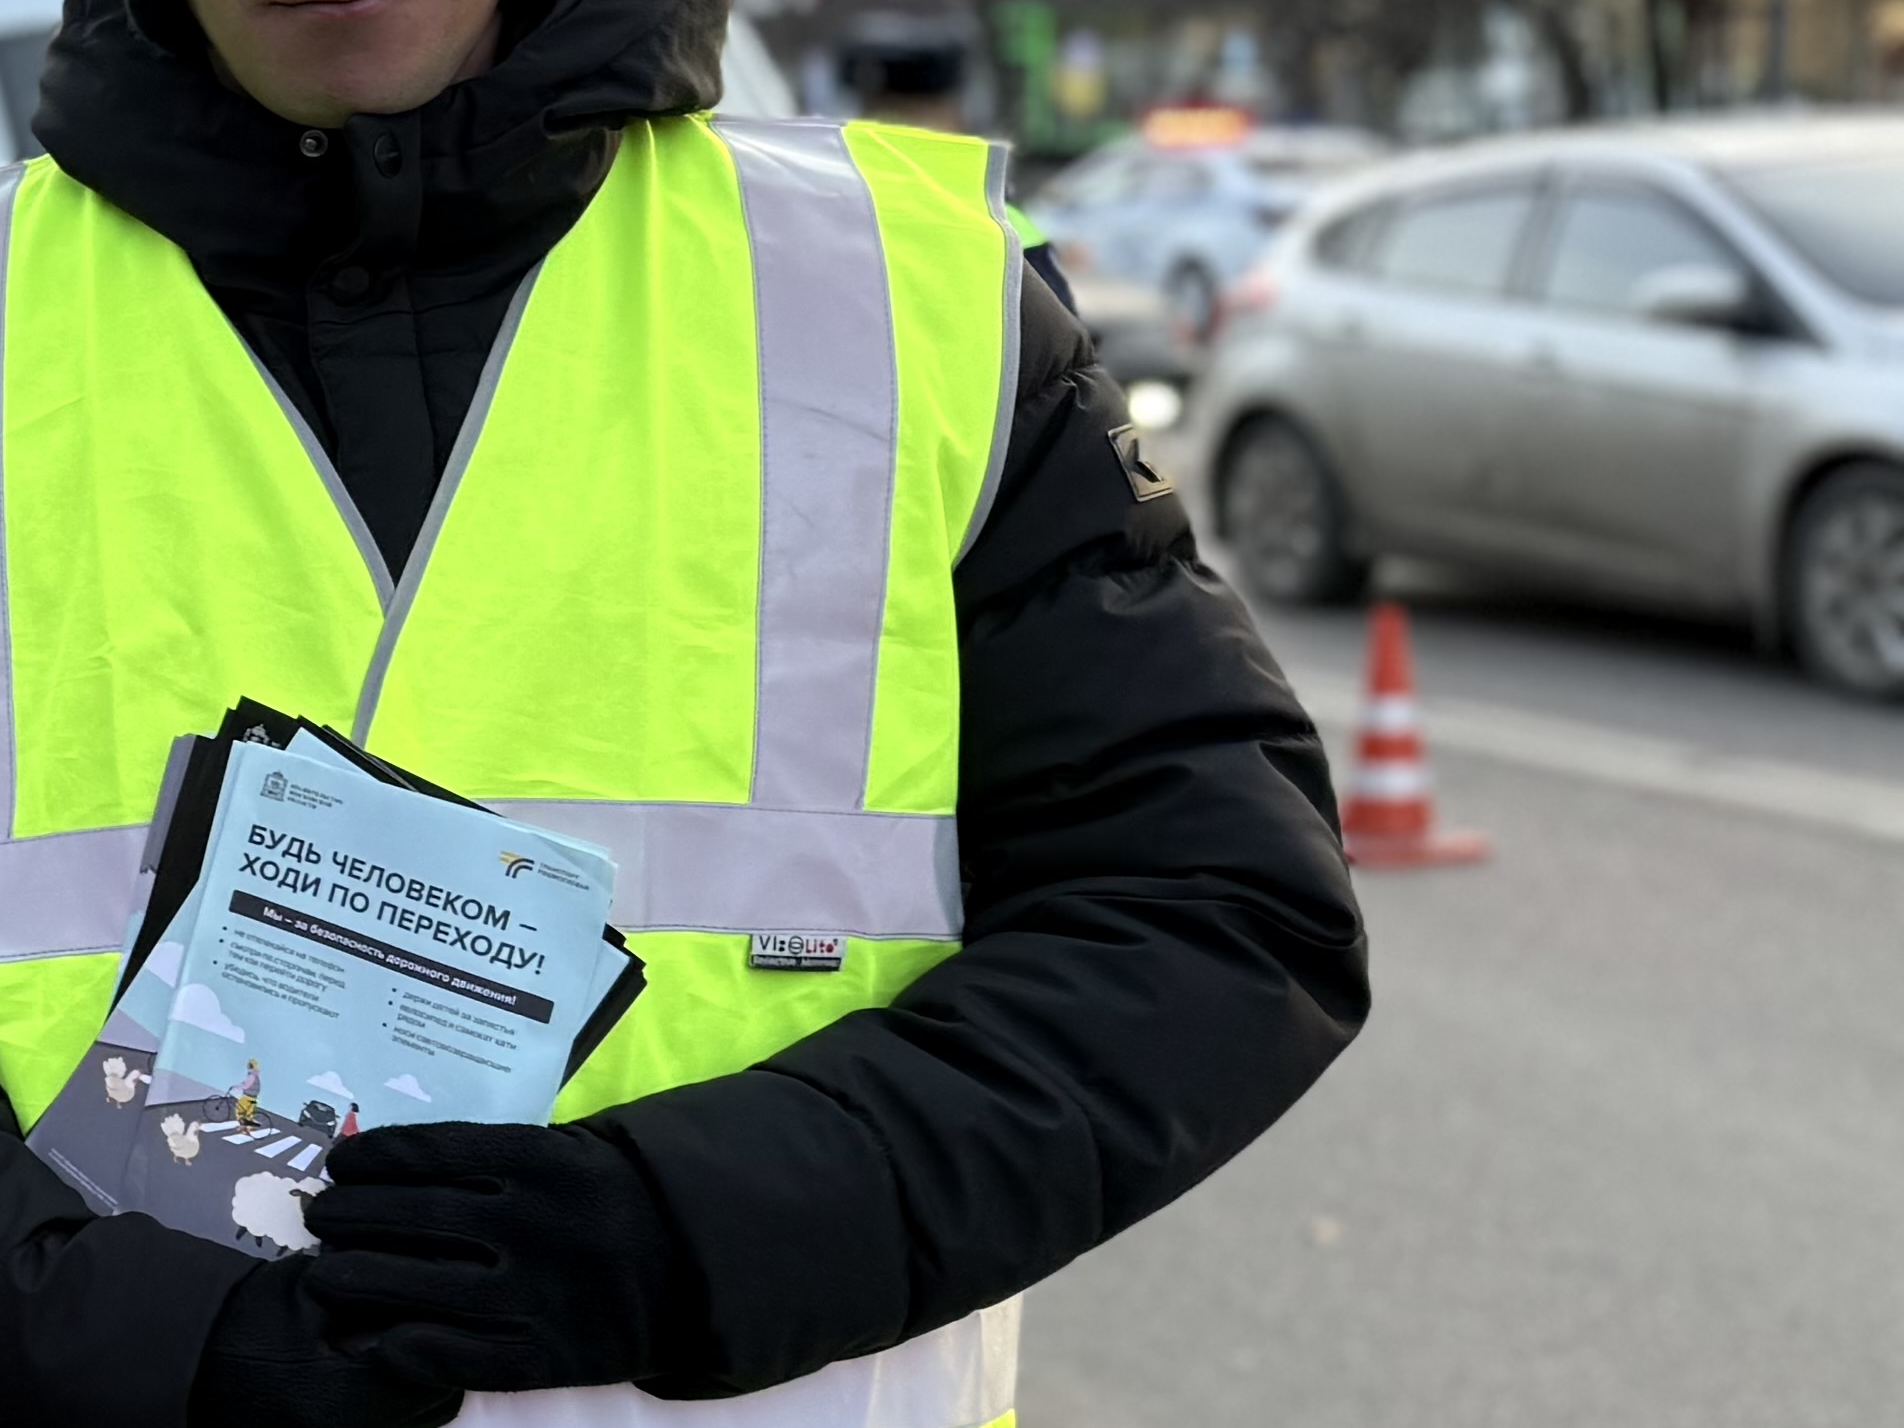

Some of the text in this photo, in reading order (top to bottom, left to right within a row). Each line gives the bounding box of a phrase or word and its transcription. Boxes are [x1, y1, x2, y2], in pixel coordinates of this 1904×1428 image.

[239, 852, 546, 976] ХОДИ ПО ПЕРЕХОДУ!
[247, 823, 323, 865] БУДЬ
[332, 850, 512, 931] ЧЕЛОВЕКОМ
[263, 906, 283, 922] Мы
[295, 921, 308, 931] за
[310, 924, 386, 960] безопасность
[386, 952, 450, 984] дорожного
[451, 976, 517, 1006] движения!
